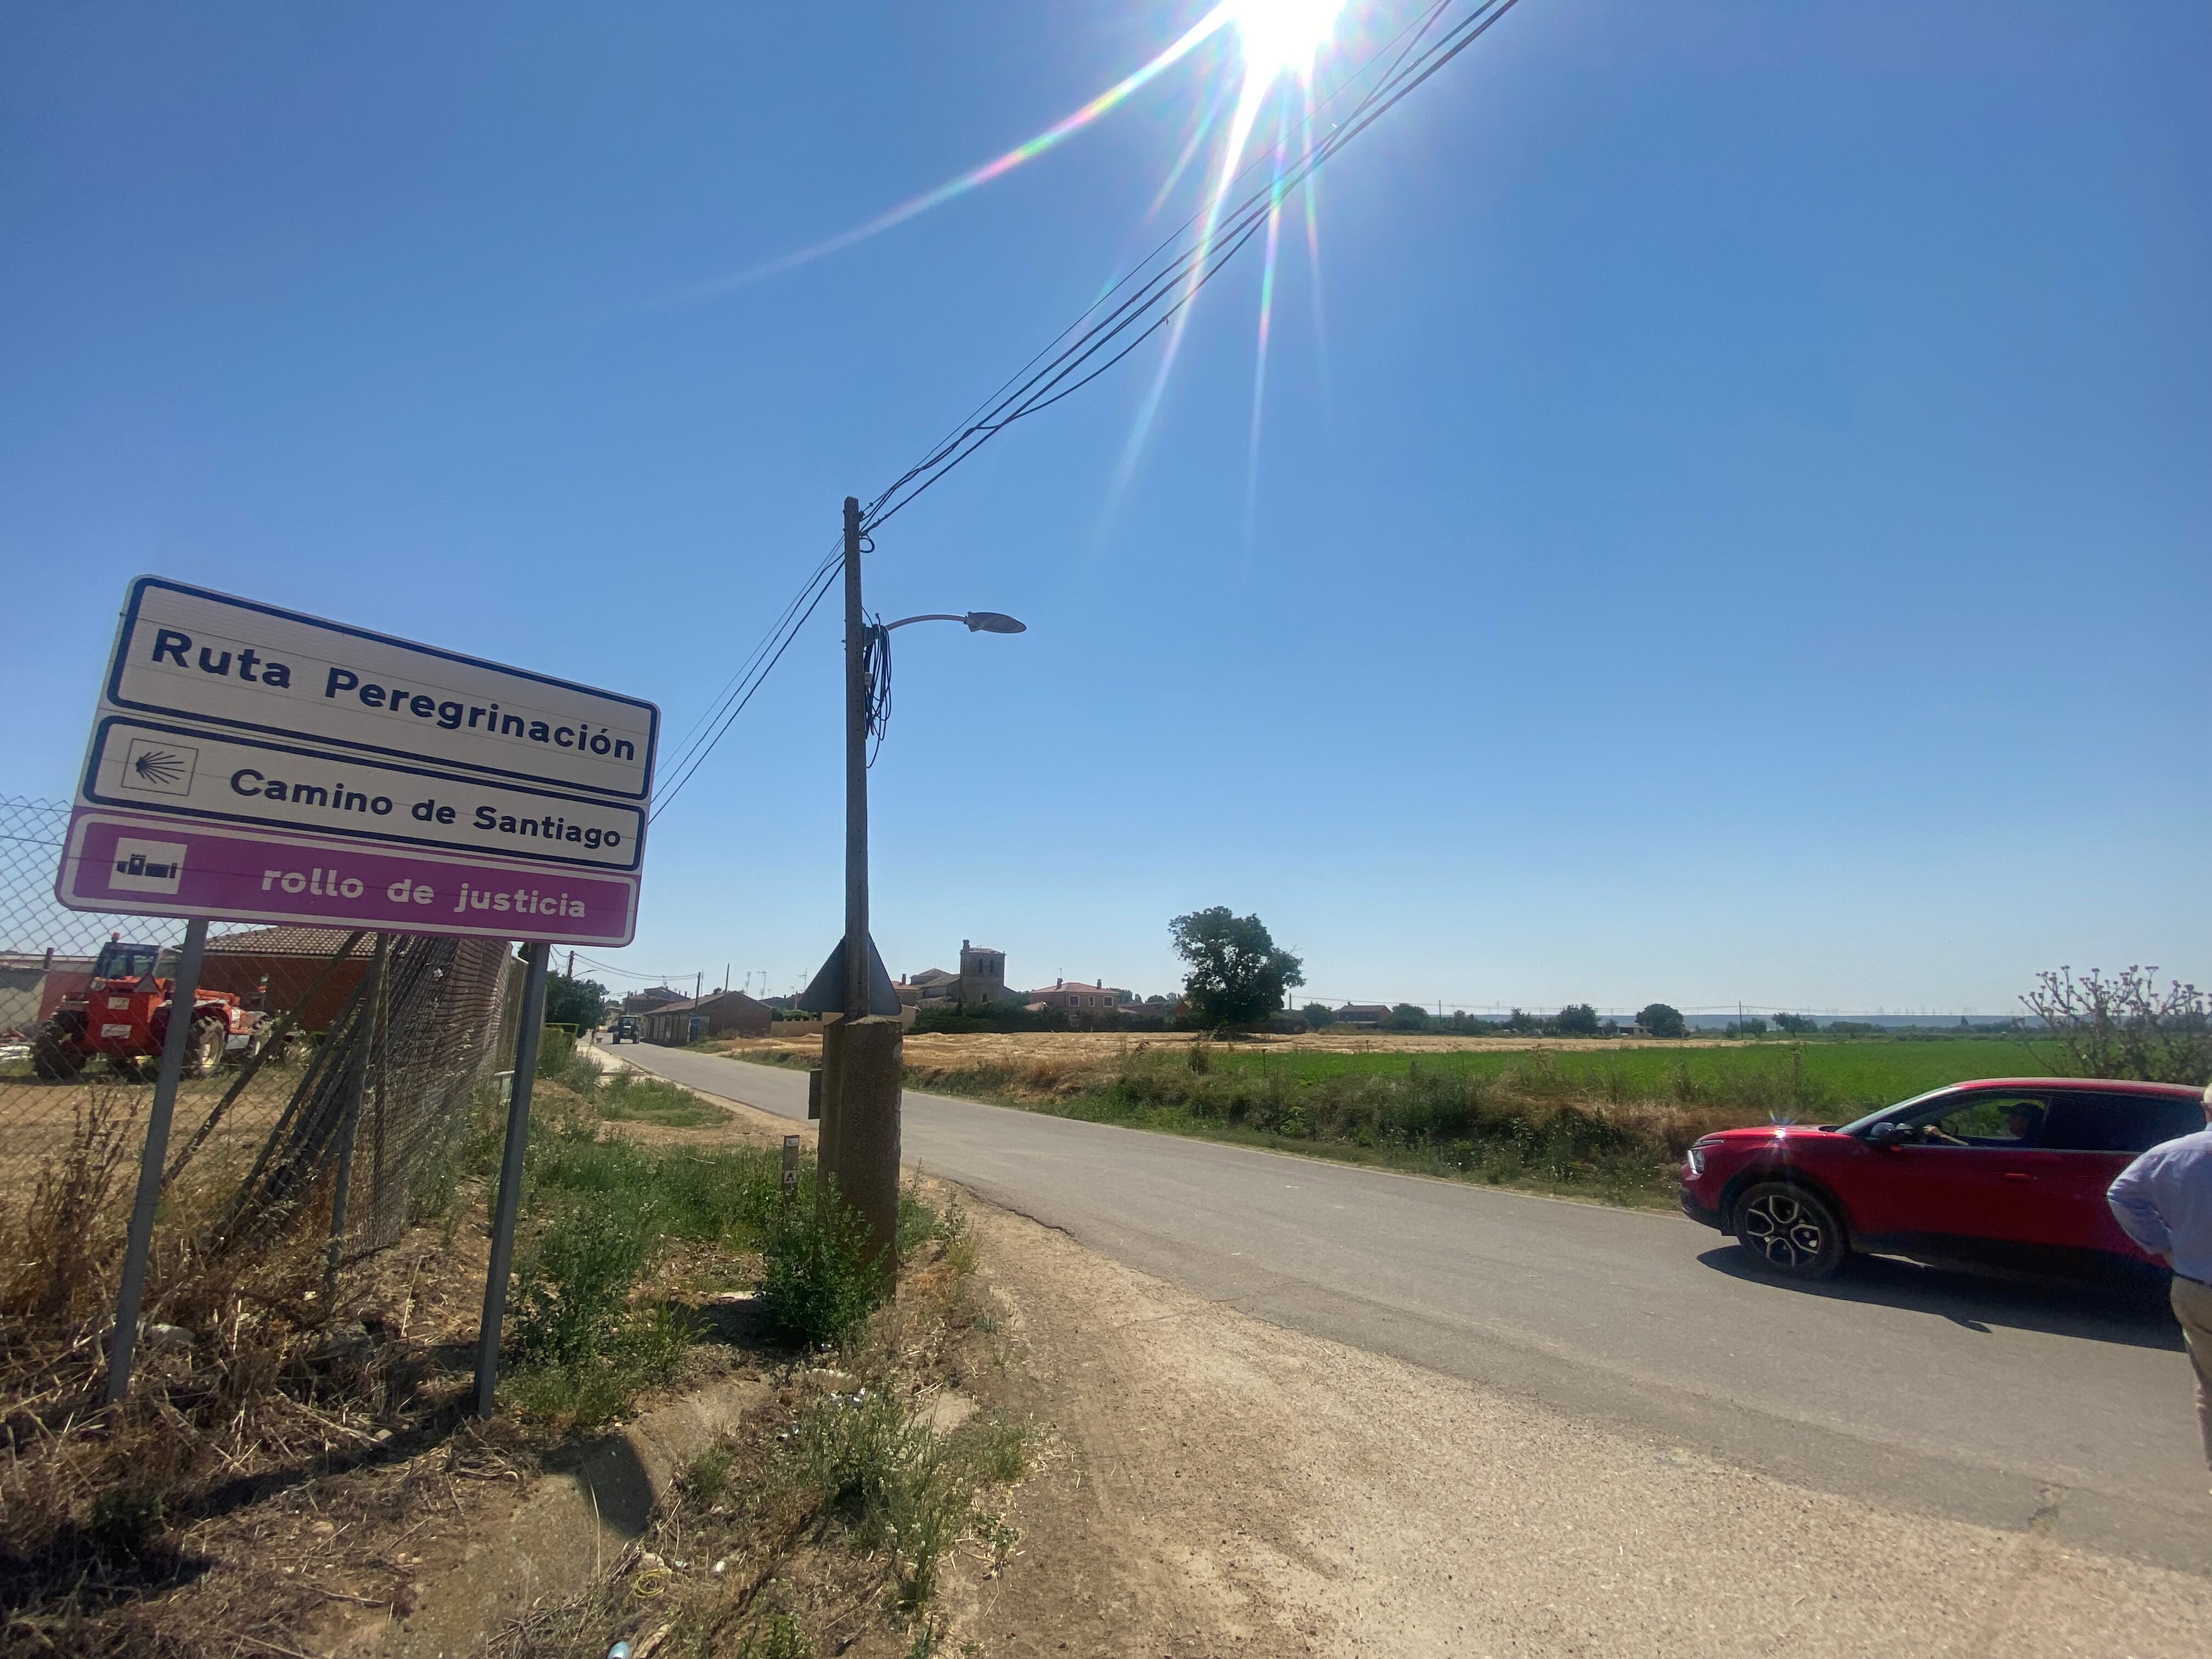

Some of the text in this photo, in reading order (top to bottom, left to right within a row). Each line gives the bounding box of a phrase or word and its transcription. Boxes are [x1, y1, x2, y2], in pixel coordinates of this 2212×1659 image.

[151, 628, 635, 761] Ruta Peregrinación
[230, 769, 620, 849] Camino de Santiago
[261, 868, 585, 918] rollo de justicia
